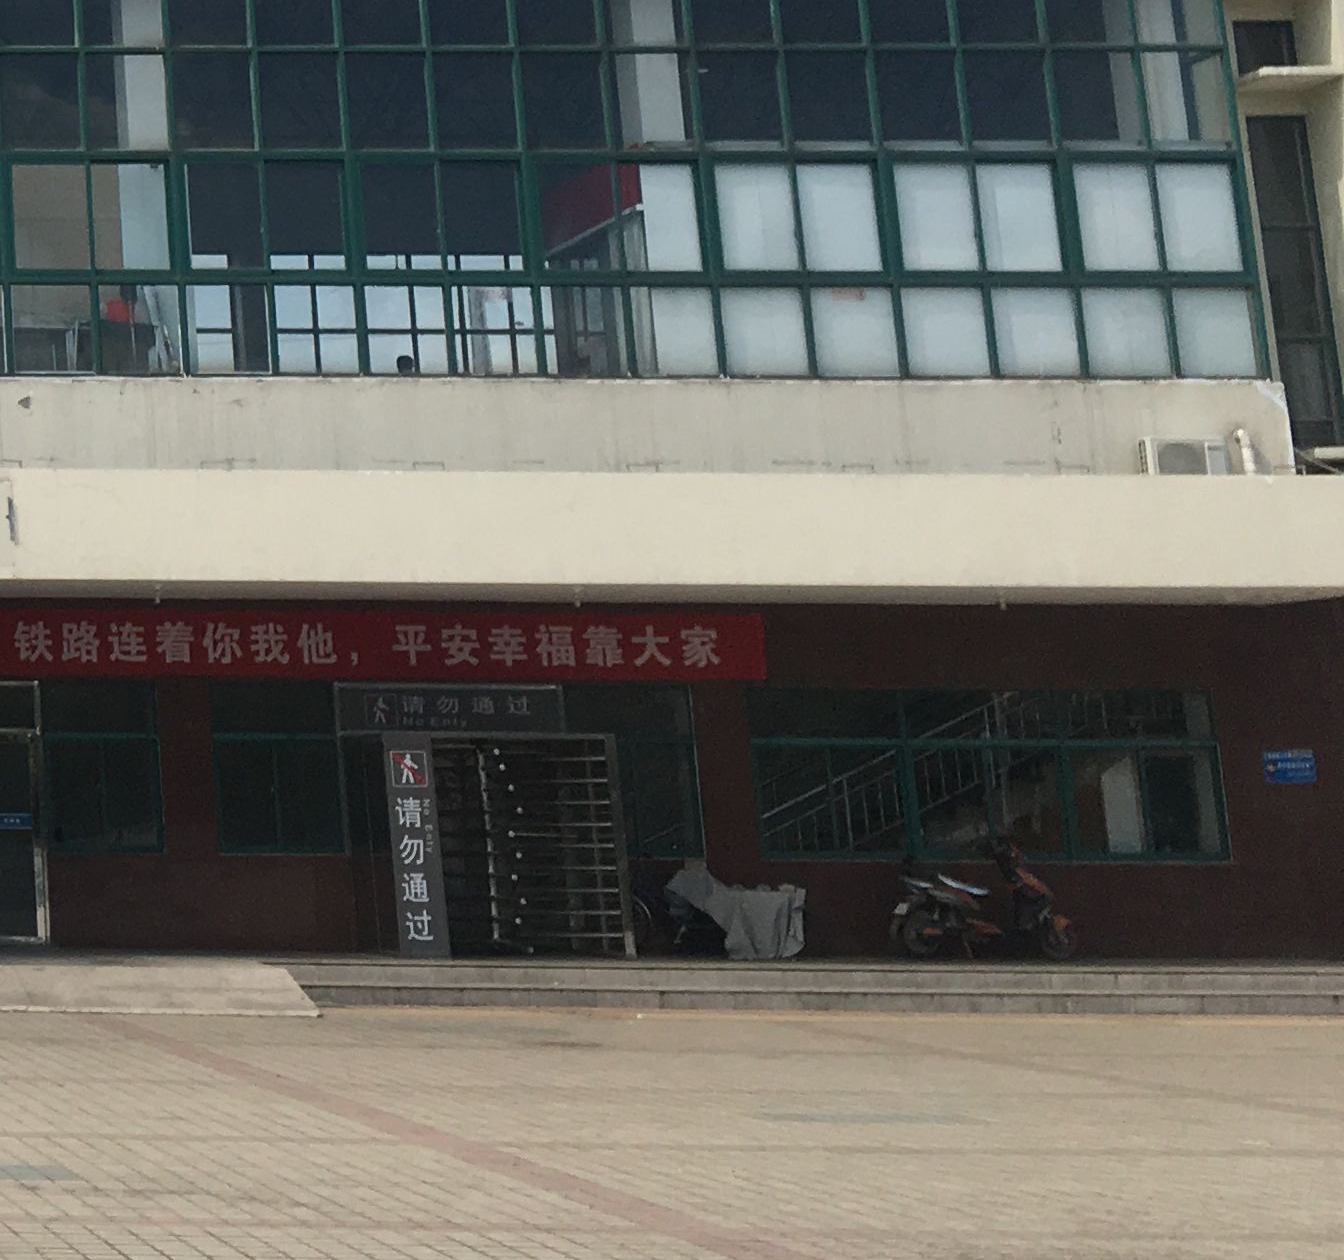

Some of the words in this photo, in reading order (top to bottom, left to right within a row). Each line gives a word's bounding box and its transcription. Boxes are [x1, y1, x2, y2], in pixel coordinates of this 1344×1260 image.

[401, 695, 531, 716] 请勿通过
[395, 797, 434, 941] 请勿通过
